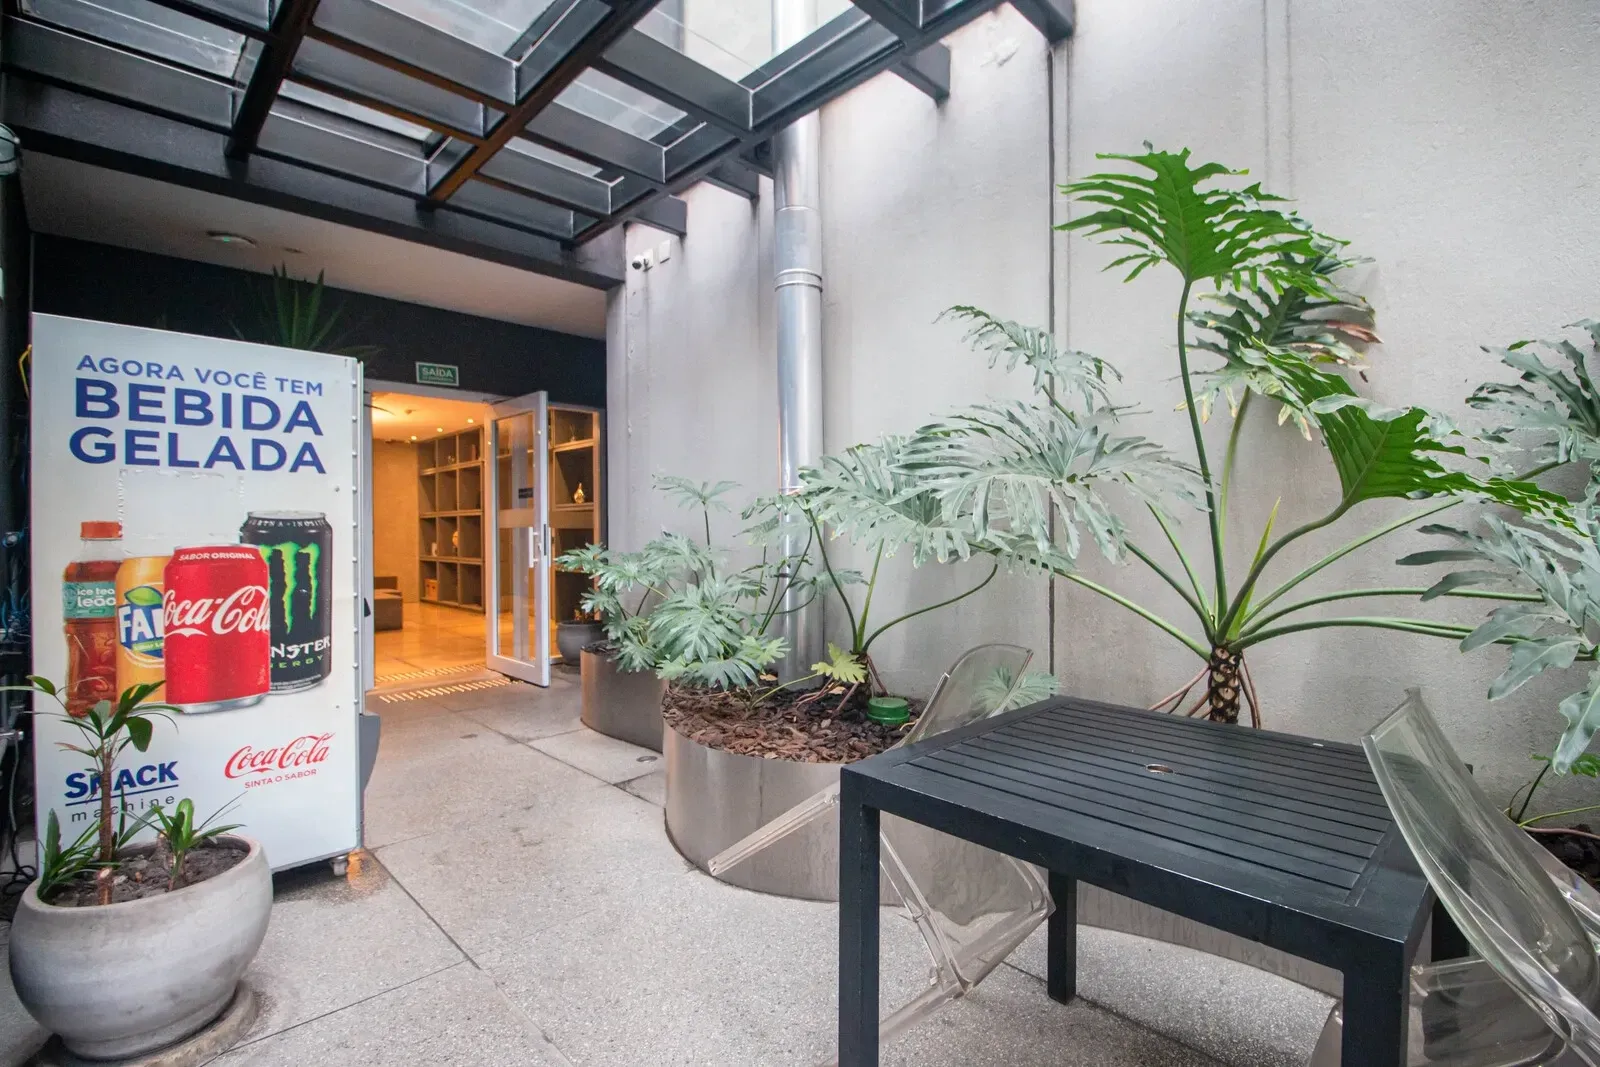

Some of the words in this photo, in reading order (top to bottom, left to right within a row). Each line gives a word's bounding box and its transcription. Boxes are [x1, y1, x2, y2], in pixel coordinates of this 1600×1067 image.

[76, 355, 185, 381] AGORA
[194, 368, 267, 389] VOCÊ
[275, 377, 323, 396] TEM
[75, 377, 324, 436] BEBIDA
[69, 426, 327, 474] GELADA
[179, 553, 210, 561] SABOR
[211, 552, 256, 560] ORIGINAL
[270, 635, 331, 660] NSTER
[271, 655, 323, 668] ERGY
[224, 732, 336, 779] Coca-Cola
[244, 776, 273, 789] SINTA
[274, 775, 283, 783] O
[285, 768, 317, 781] SABOR
